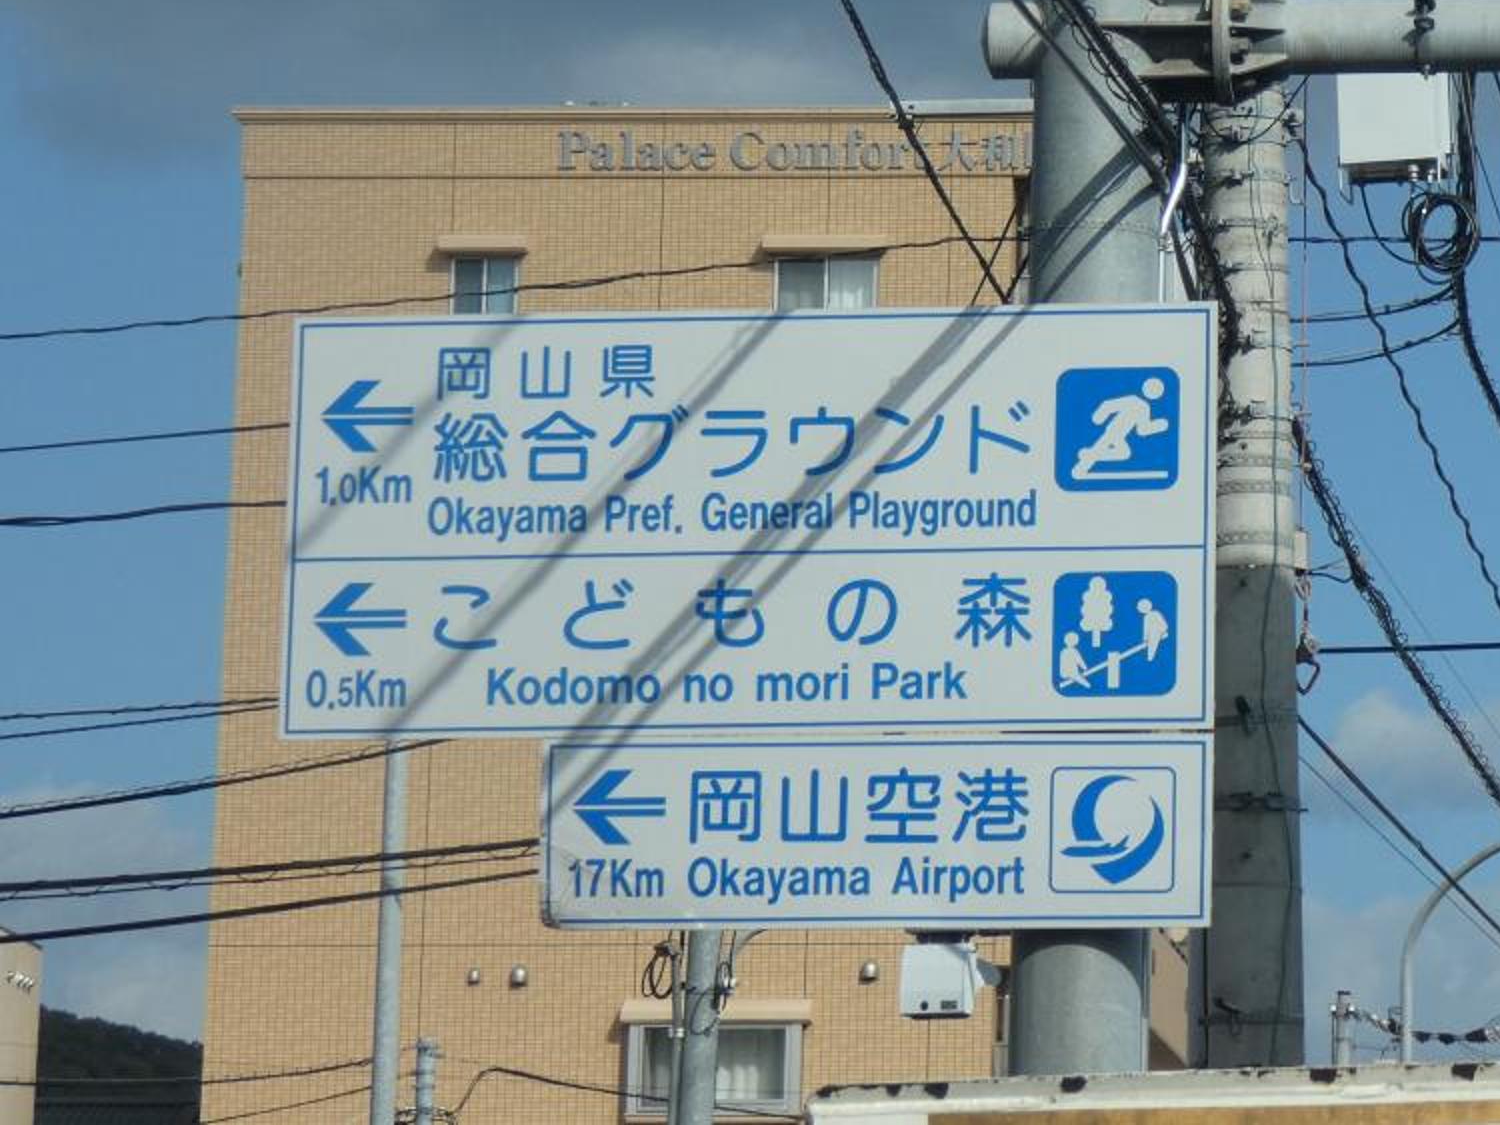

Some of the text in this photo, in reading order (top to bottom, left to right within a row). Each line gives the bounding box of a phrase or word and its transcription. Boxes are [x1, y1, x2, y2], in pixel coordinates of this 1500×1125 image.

[556, 130, 717, 171] Palace
[438, 343, 655, 399] 岡山県
[433, 403, 1032, 485] 総合グラウンド
[316, 467, 413, 507] 1.0Km
[427, 487, 1038, 541] Okayama Pref. General Playground
[432, 573, 1033, 651] こどもの森
[304, 668, 409, 709] 0.5Km
[487, 660, 968, 707] Kodomo no mori Park
[687, 765, 1030, 847] 岡山空港
[571, 857, 666, 898] 17Km
[686, 856, 1024, 902] Okayama Airport
